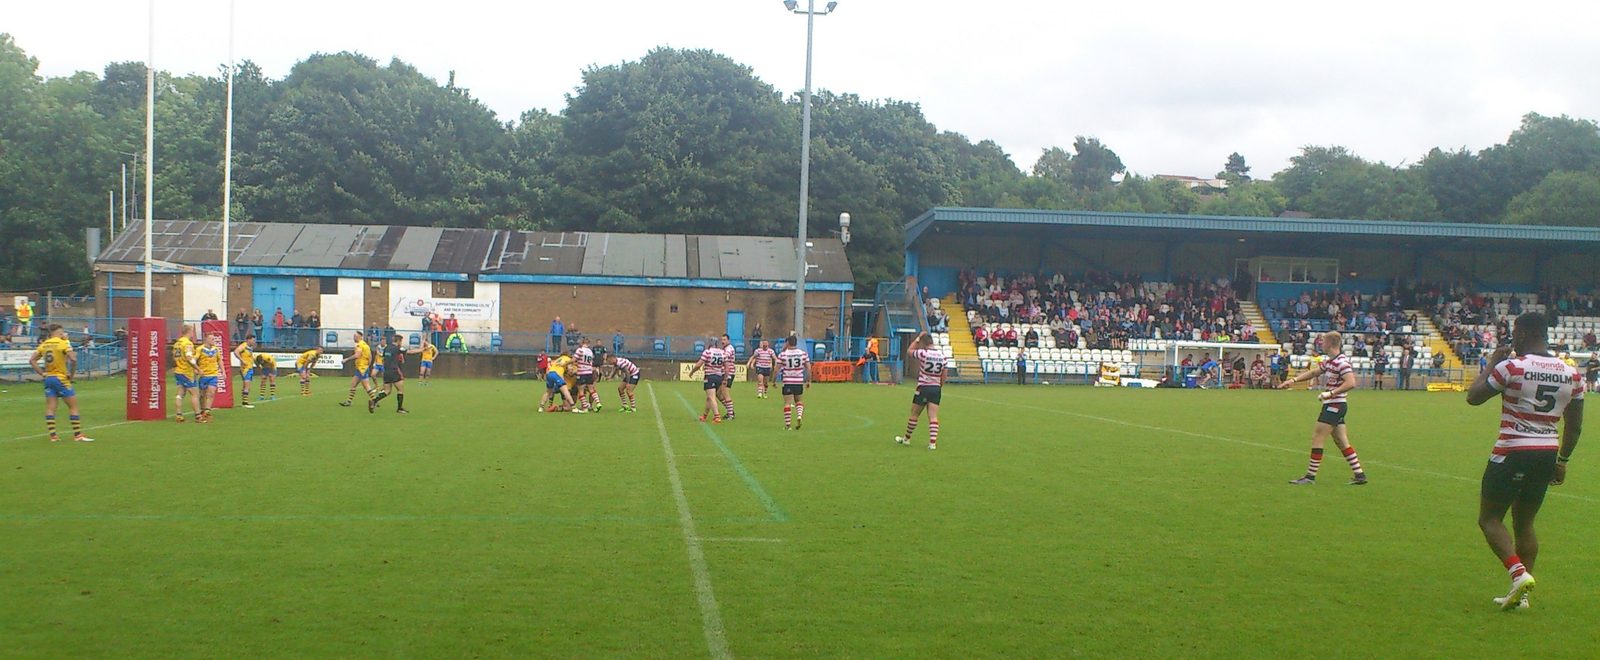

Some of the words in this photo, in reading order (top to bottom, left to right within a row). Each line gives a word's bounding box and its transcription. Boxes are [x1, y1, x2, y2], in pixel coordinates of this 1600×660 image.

[149, 330, 159, 357] Press
[44, 350, 54, 364] 6
[711, 356, 723, 366] 26
[788, 358, 801, 368] 13
[924, 361, 943, 374] 23
[149, 360, 161, 409] Kingstone
[1524, 372, 1573, 385] CHISHOLM
[1534, 385, 1560, 412] 5
